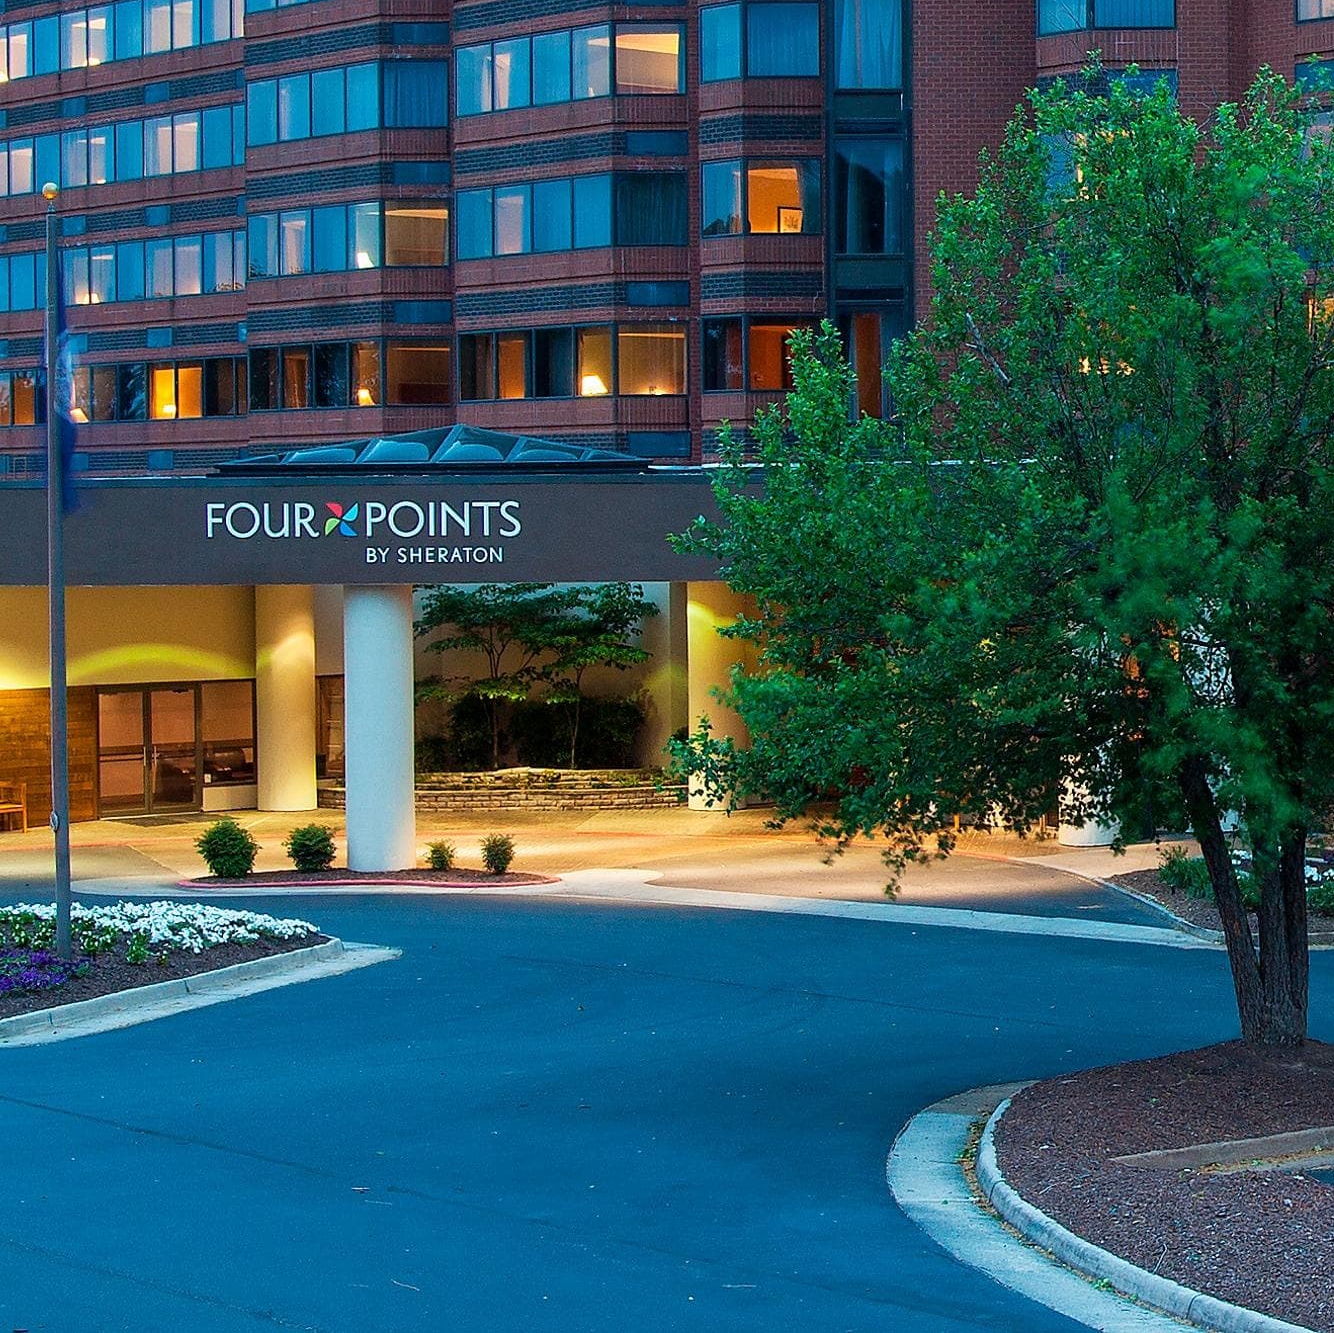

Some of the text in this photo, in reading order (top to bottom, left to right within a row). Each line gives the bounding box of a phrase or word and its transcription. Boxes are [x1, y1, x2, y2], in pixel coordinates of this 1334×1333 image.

[206, 500, 522, 539] FOUR POINTS
[366, 547, 503, 563] BY SHERATON
